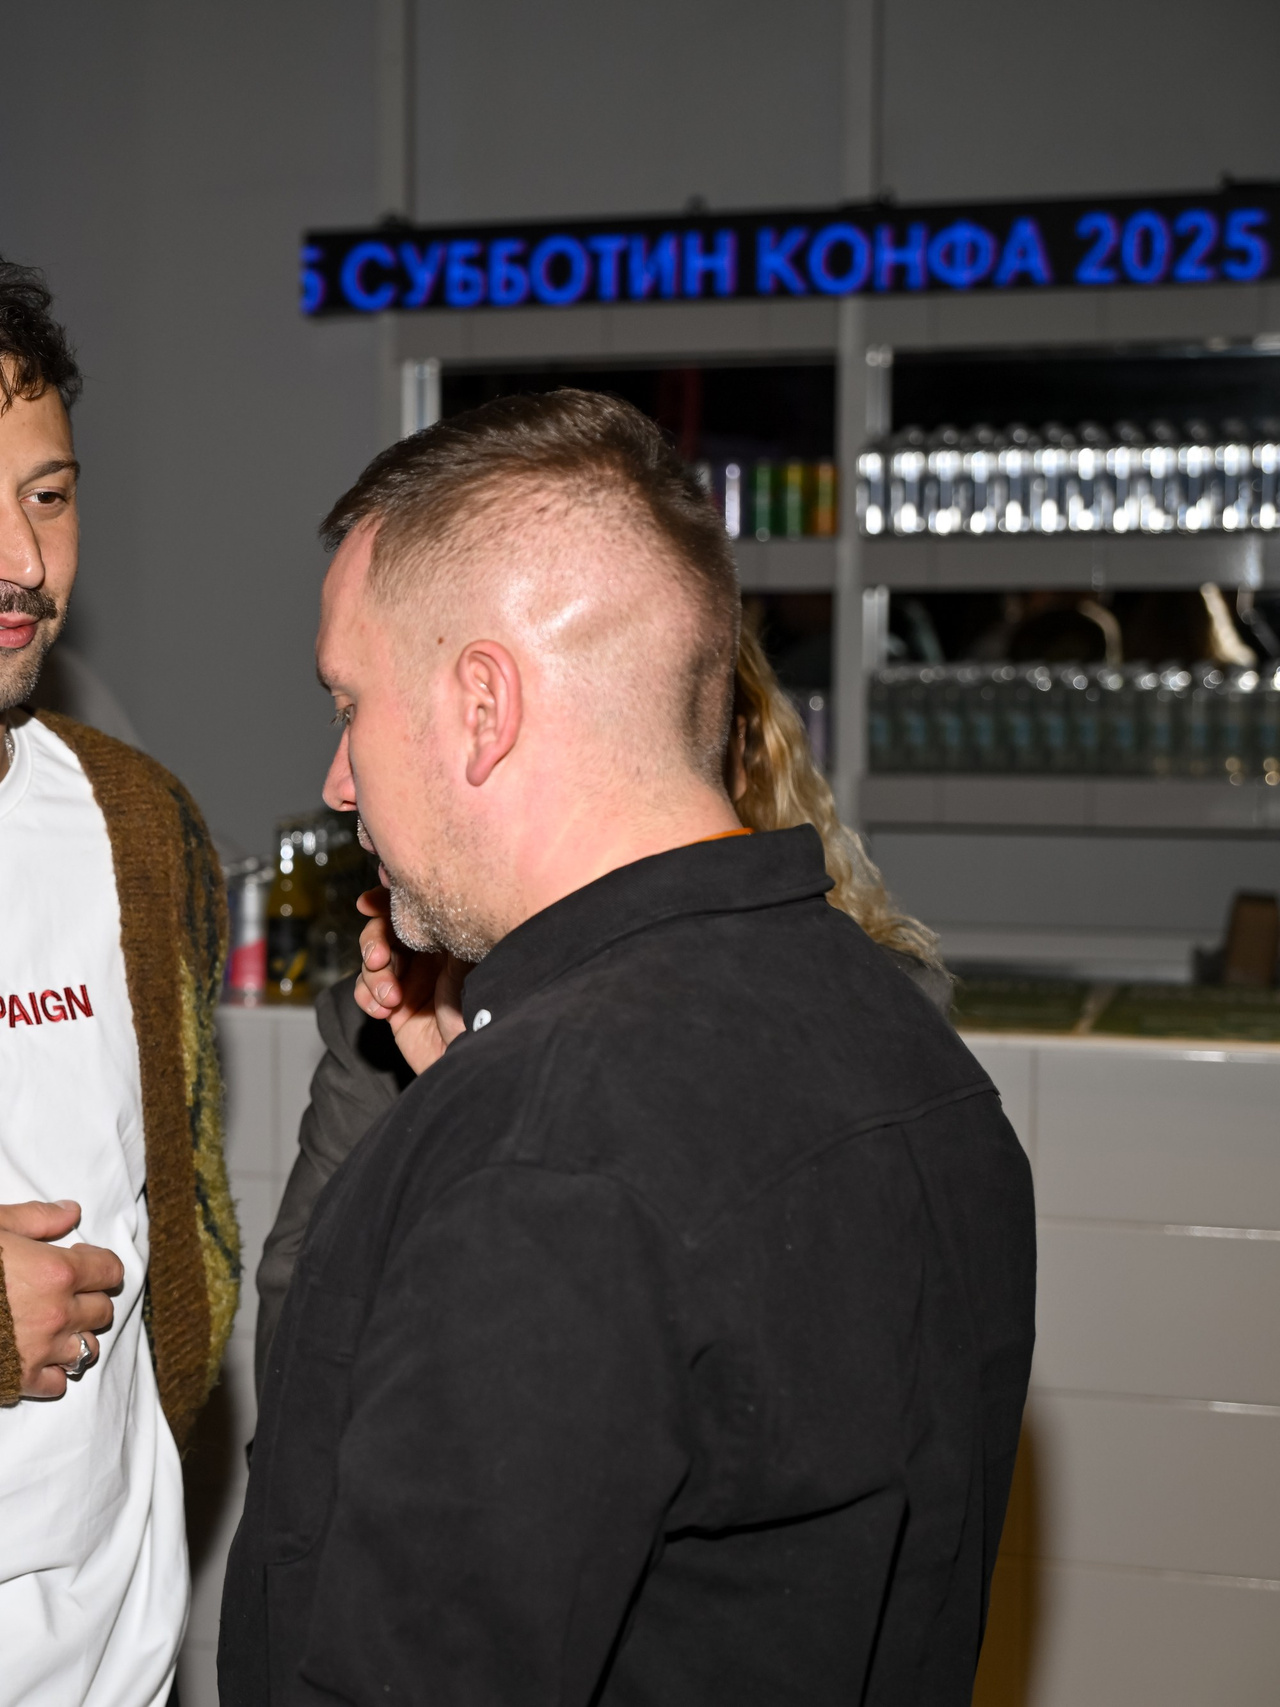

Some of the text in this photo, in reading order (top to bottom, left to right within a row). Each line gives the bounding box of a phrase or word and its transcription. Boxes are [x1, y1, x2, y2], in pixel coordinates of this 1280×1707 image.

[339, 229, 735, 311] СУББОТИН
[756, 217, 1053, 296] КОНФА
[1074, 207, 1269, 286] 2025
